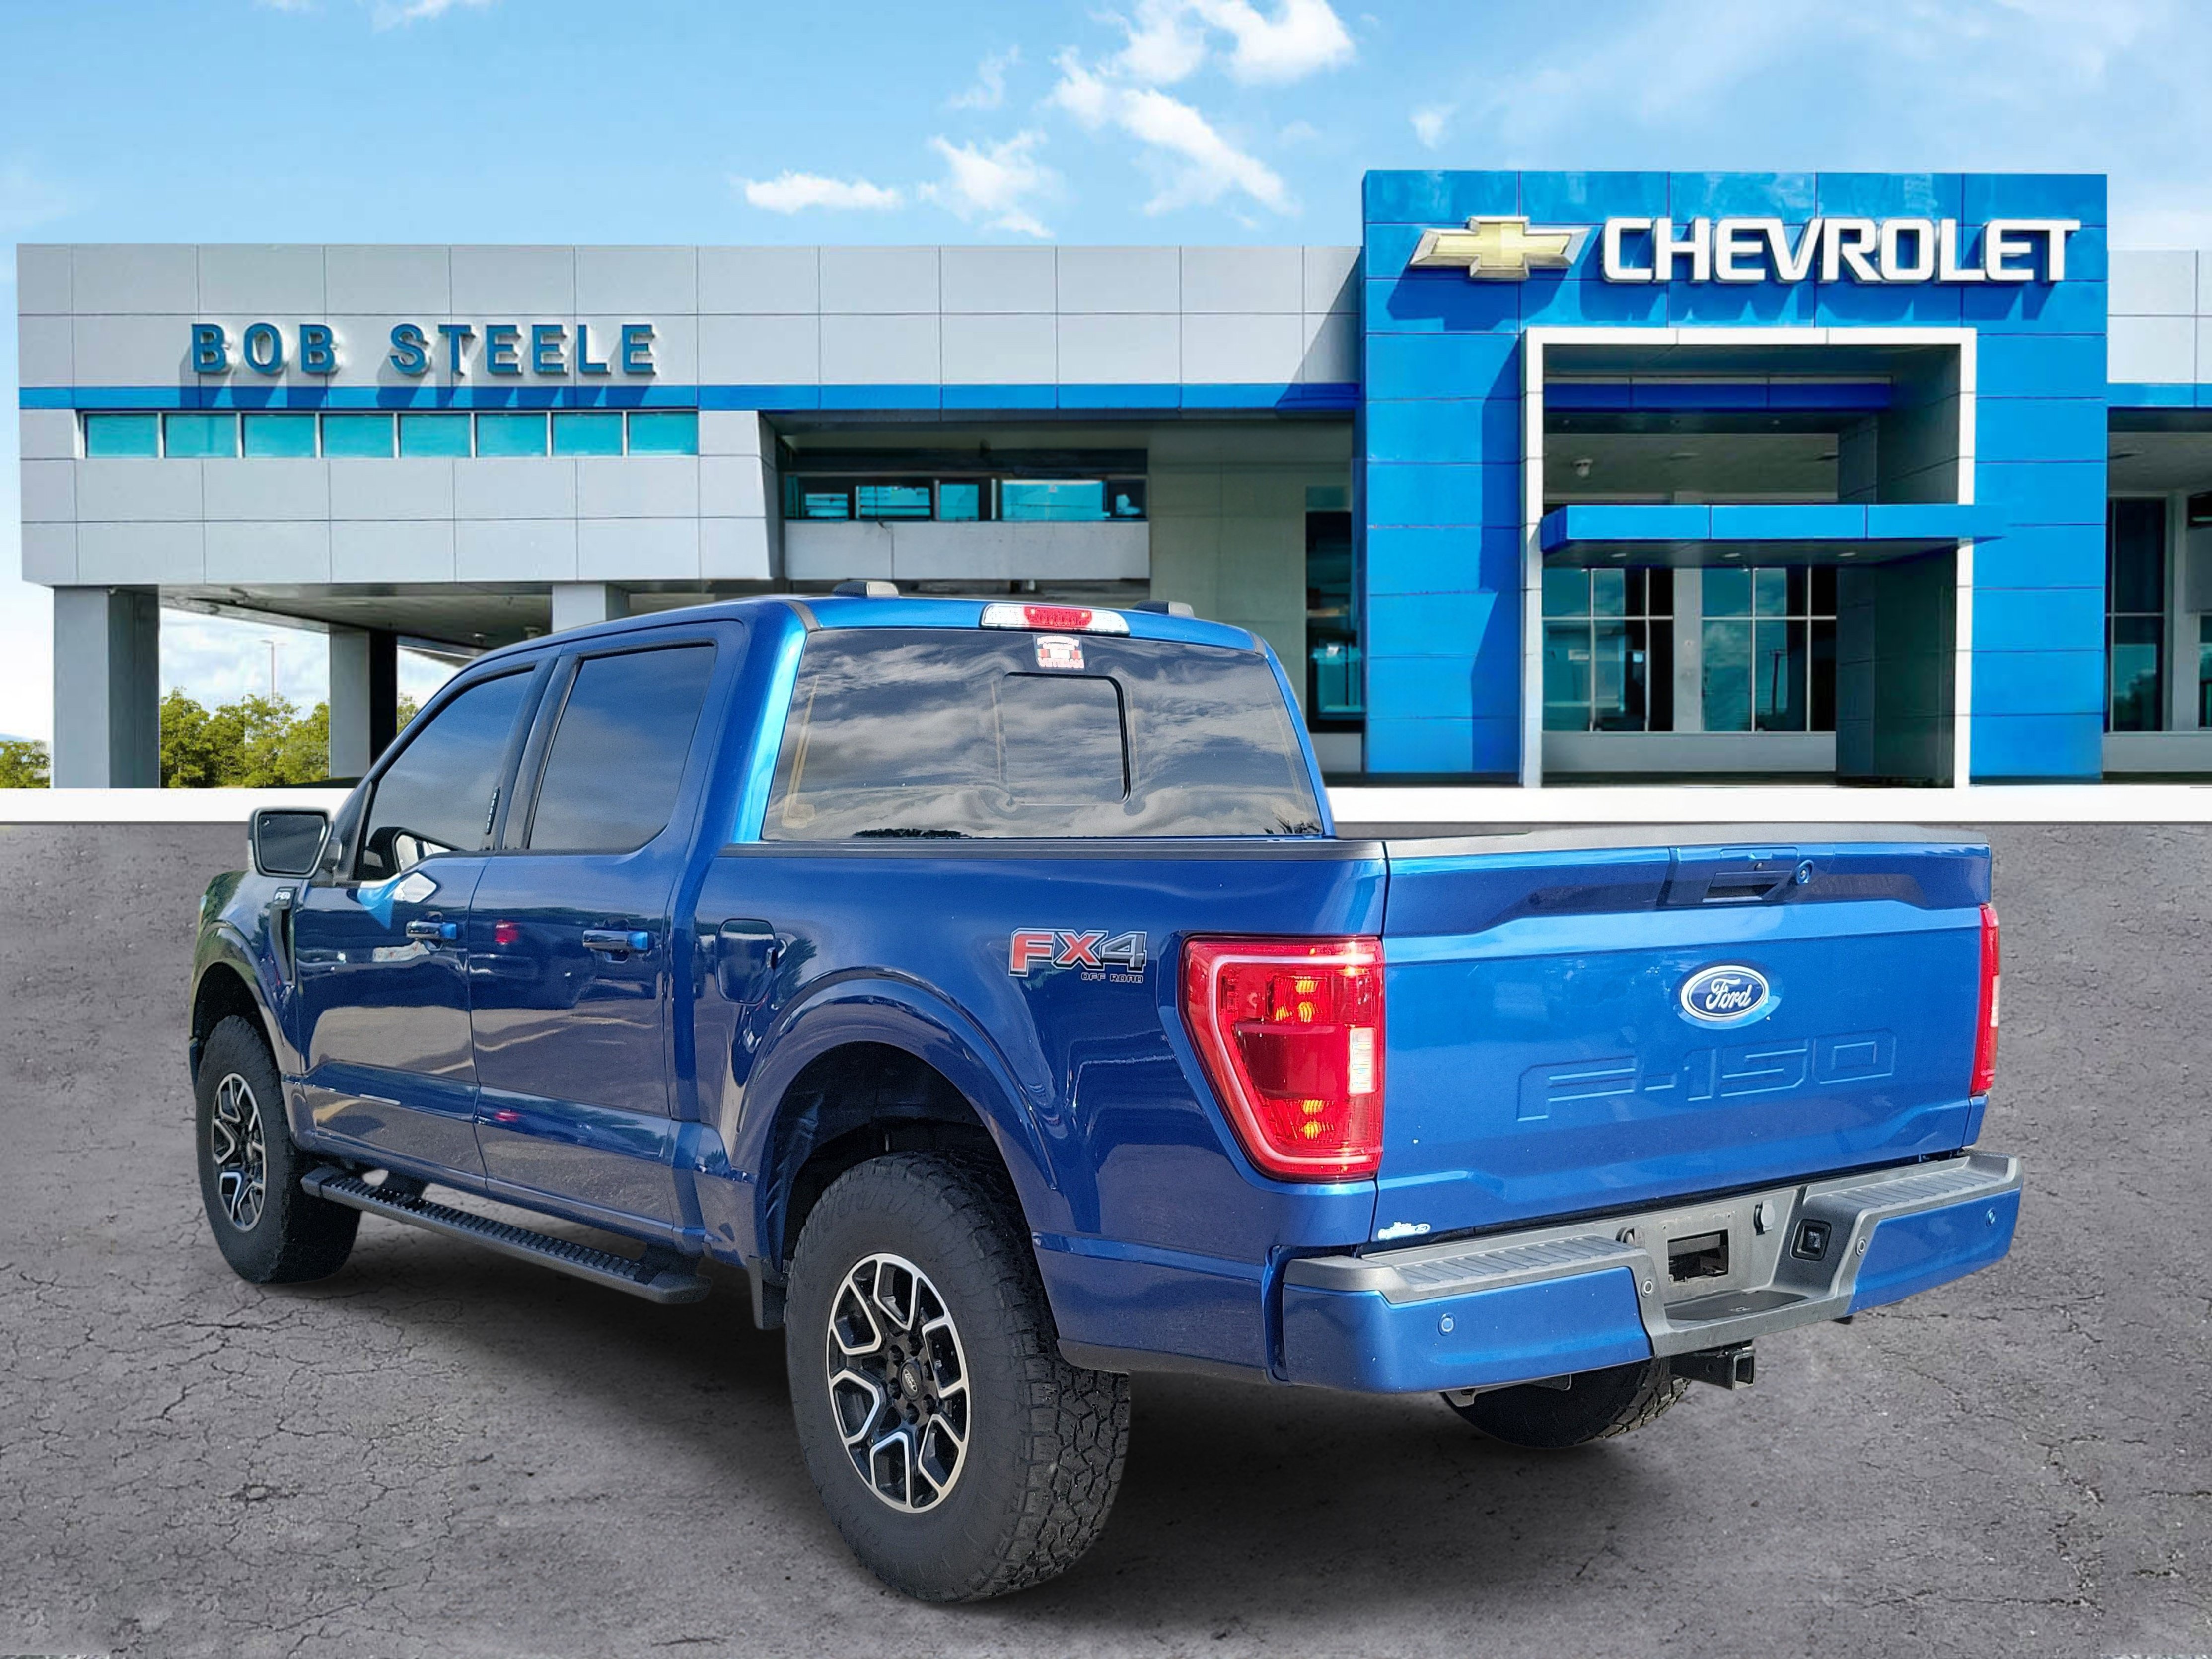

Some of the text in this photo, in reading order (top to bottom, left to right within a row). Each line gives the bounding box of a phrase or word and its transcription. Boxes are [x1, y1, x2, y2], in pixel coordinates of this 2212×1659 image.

[1601, 217, 2081, 283] CHEVROLET
[191, 323, 657, 377] BOB STEELE
[1008, 927, 1147, 977] FX4
[1080, 971, 1144, 984] OFF ROAD
[1705, 977, 1753, 1010] Ford
[1517, 1027, 1897, 1122] F-150
